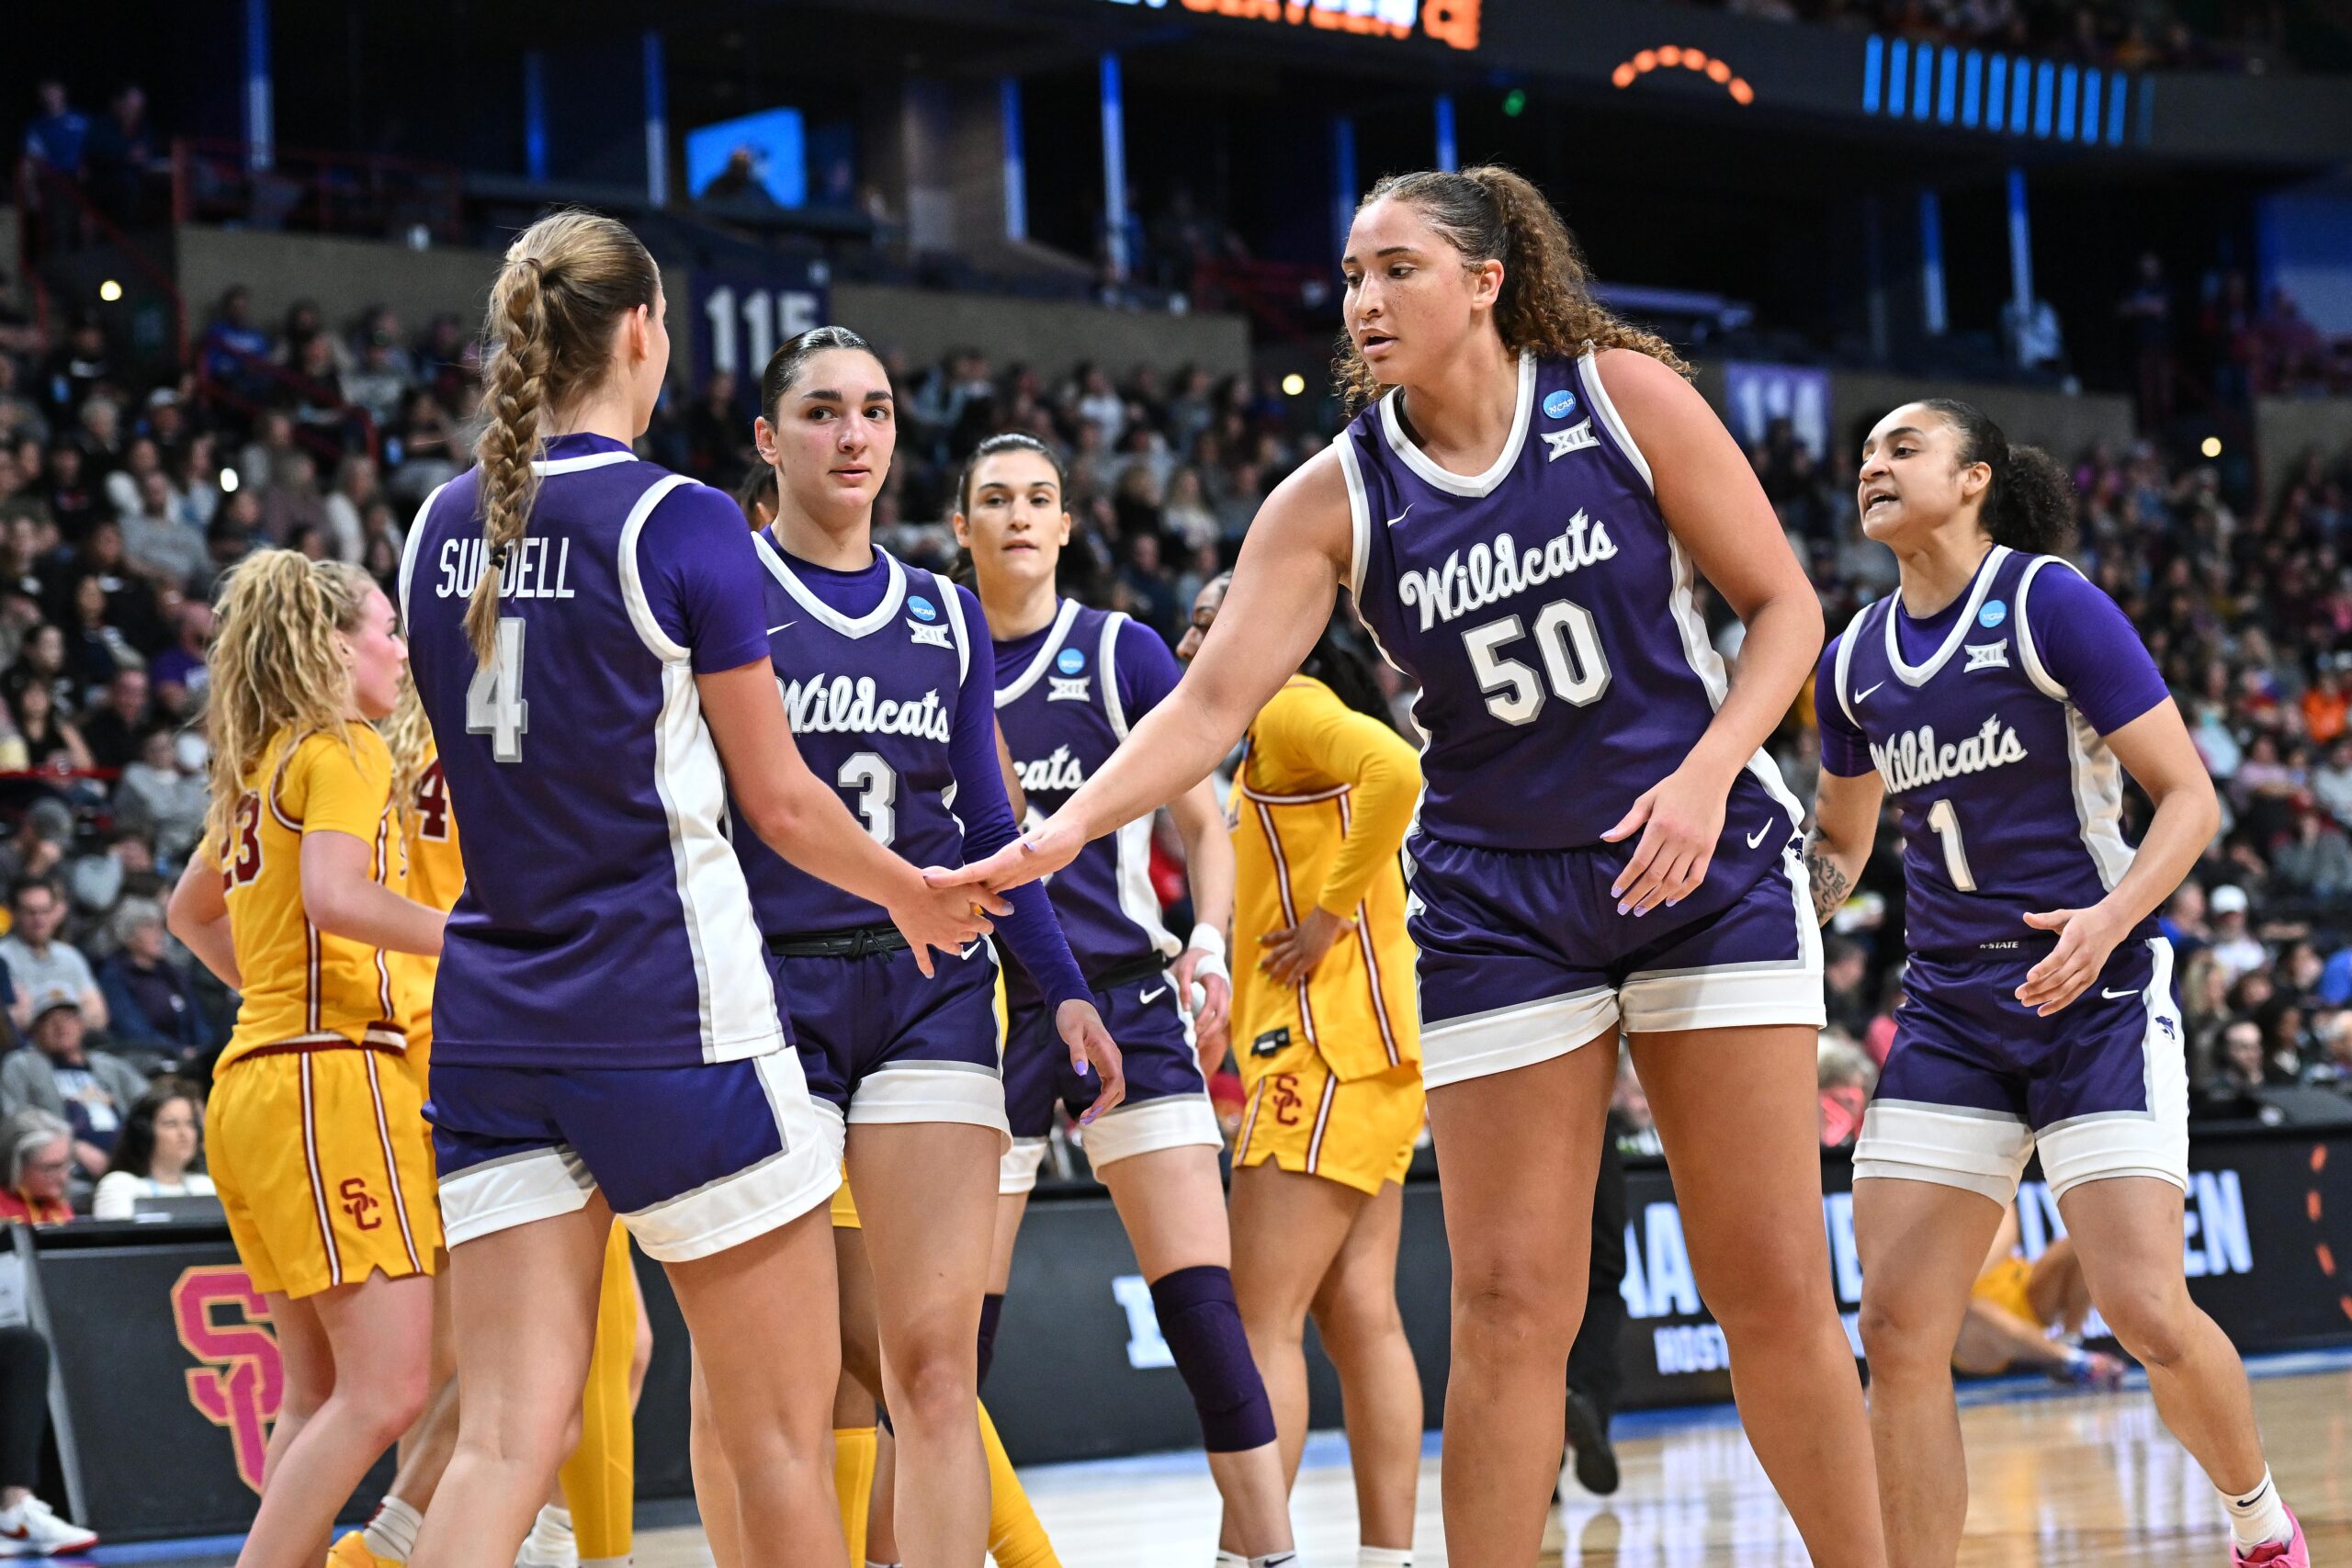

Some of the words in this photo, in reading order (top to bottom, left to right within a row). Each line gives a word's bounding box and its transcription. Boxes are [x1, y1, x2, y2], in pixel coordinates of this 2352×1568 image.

[1548, 398, 1575, 413] NCAA
[1398, 507, 1619, 633] Wildcats
[466, 617, 528, 762] 4
[775, 672, 951, 743] Wildcats
[1461, 614, 1612, 726] 50
[1013, 743, 1083, 791] cats
[1870, 714, 2028, 795] Wildcats
[838, 751, 898, 848] 3
[1928, 798, 1977, 892] 1
[1272, 1074, 1302, 1126] SC
[340, 1178, 381, 1231] SC
